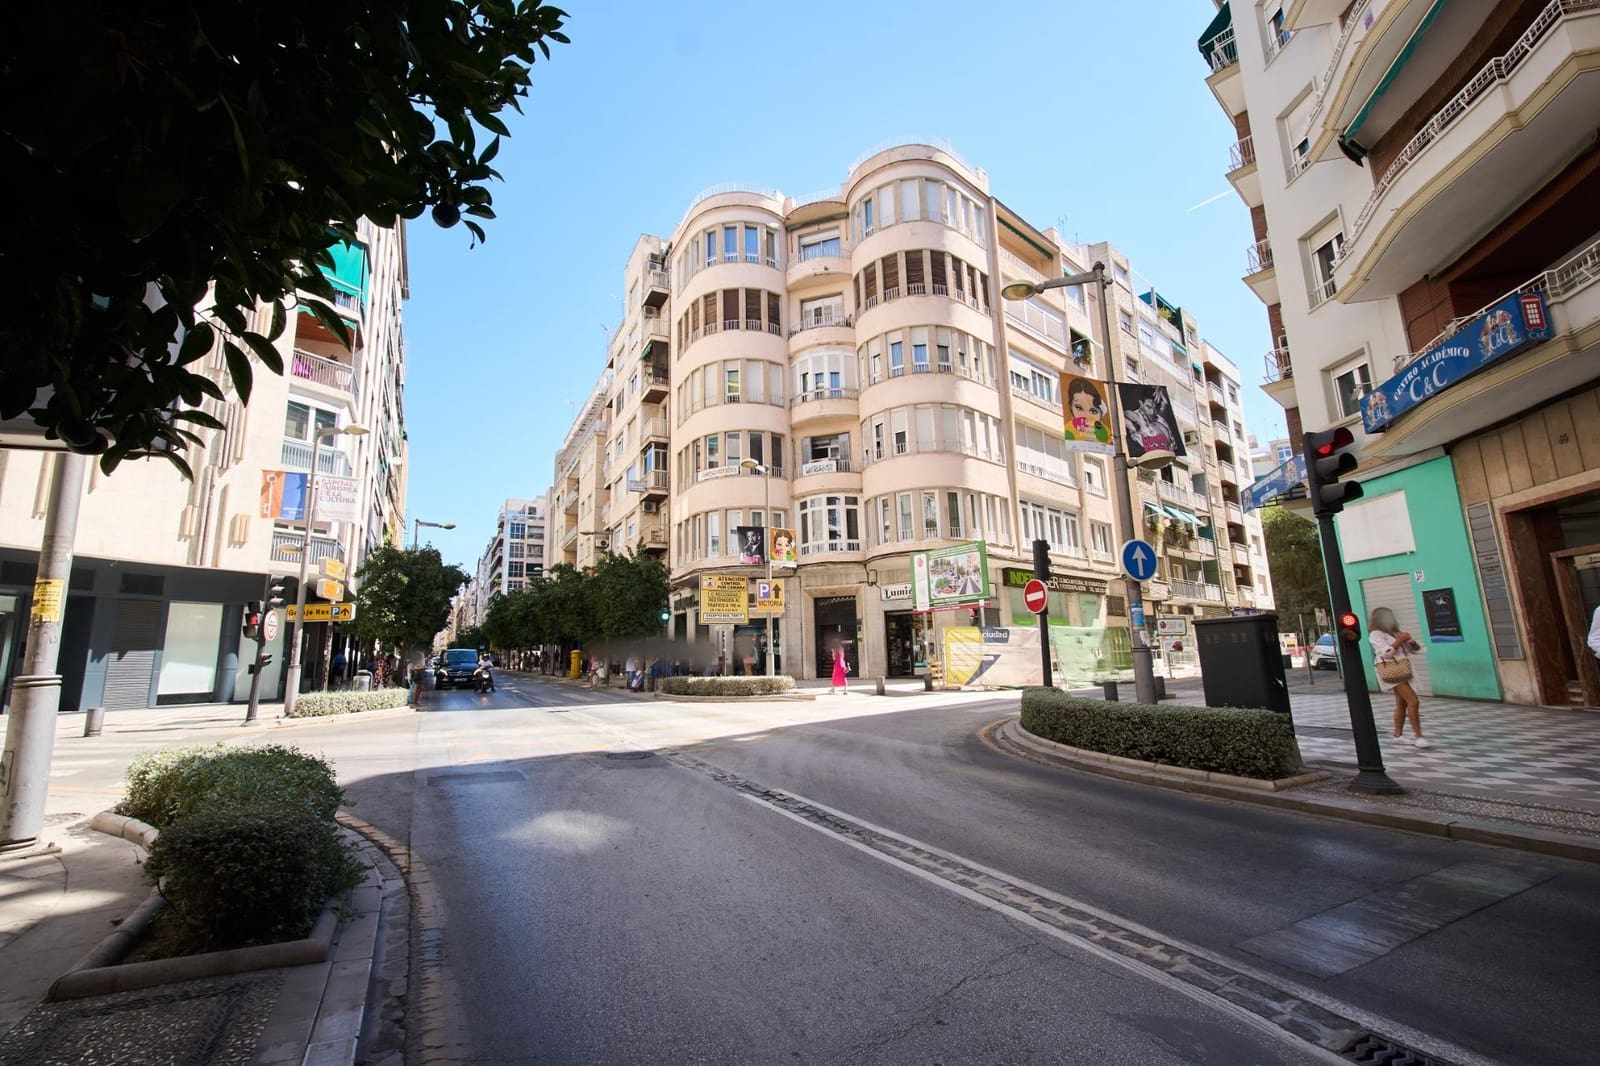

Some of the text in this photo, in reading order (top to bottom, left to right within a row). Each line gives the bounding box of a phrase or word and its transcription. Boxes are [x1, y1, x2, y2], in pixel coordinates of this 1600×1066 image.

[1394, 346, 1470, 401] CENTRO ACADÉMICO
[1410, 361, 1448, 402] C&C
[320, 496, 356, 504] CULTURA
[321, 485, 358, 493] EUROPEA
